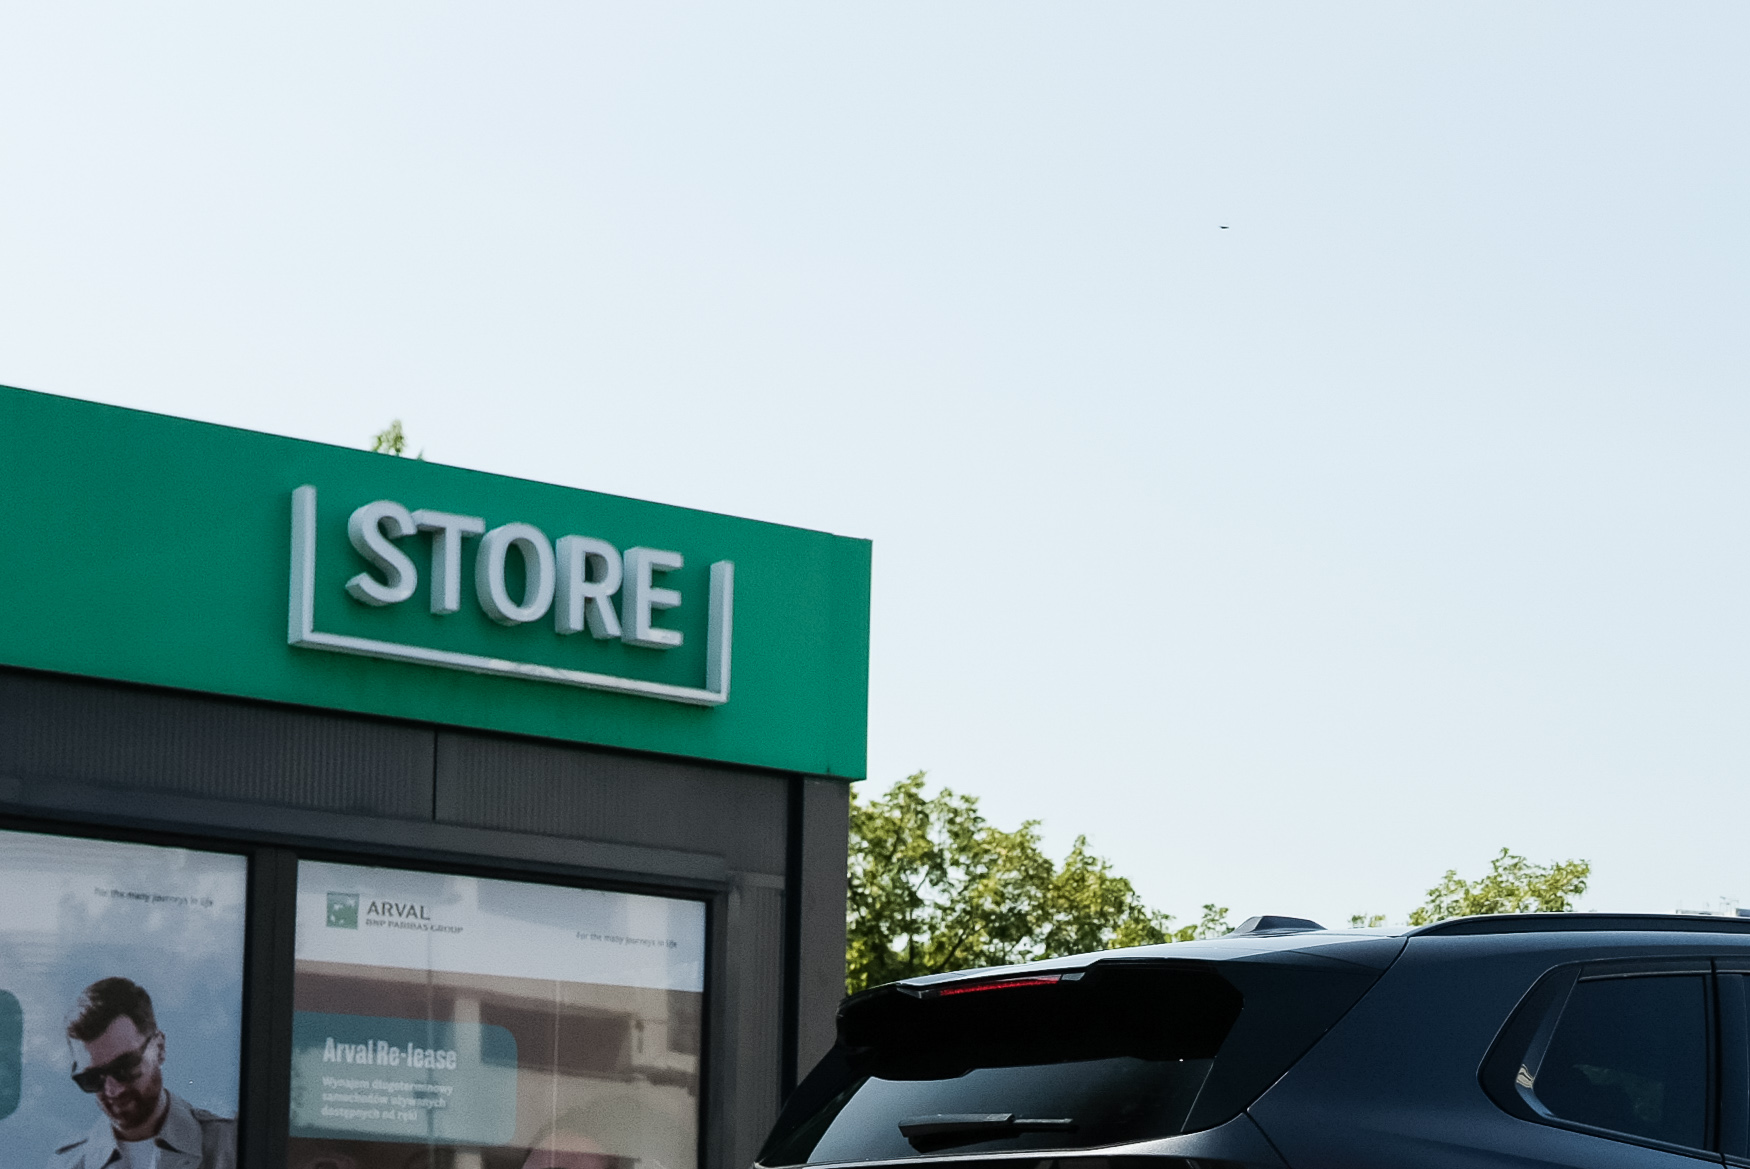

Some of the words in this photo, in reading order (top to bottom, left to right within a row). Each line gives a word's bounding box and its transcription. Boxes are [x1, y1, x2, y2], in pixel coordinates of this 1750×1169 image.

[345, 499, 684, 649] STORE
[367, 901, 431, 921] ARVAL
[365, 918, 387, 928] BNP
[388, 920, 429, 932] PARIBAS
[430, 924, 464, 935] GROUP
[322, 1036, 374, 1065] Arval
[376, 1039, 458, 1071] Re-lease
